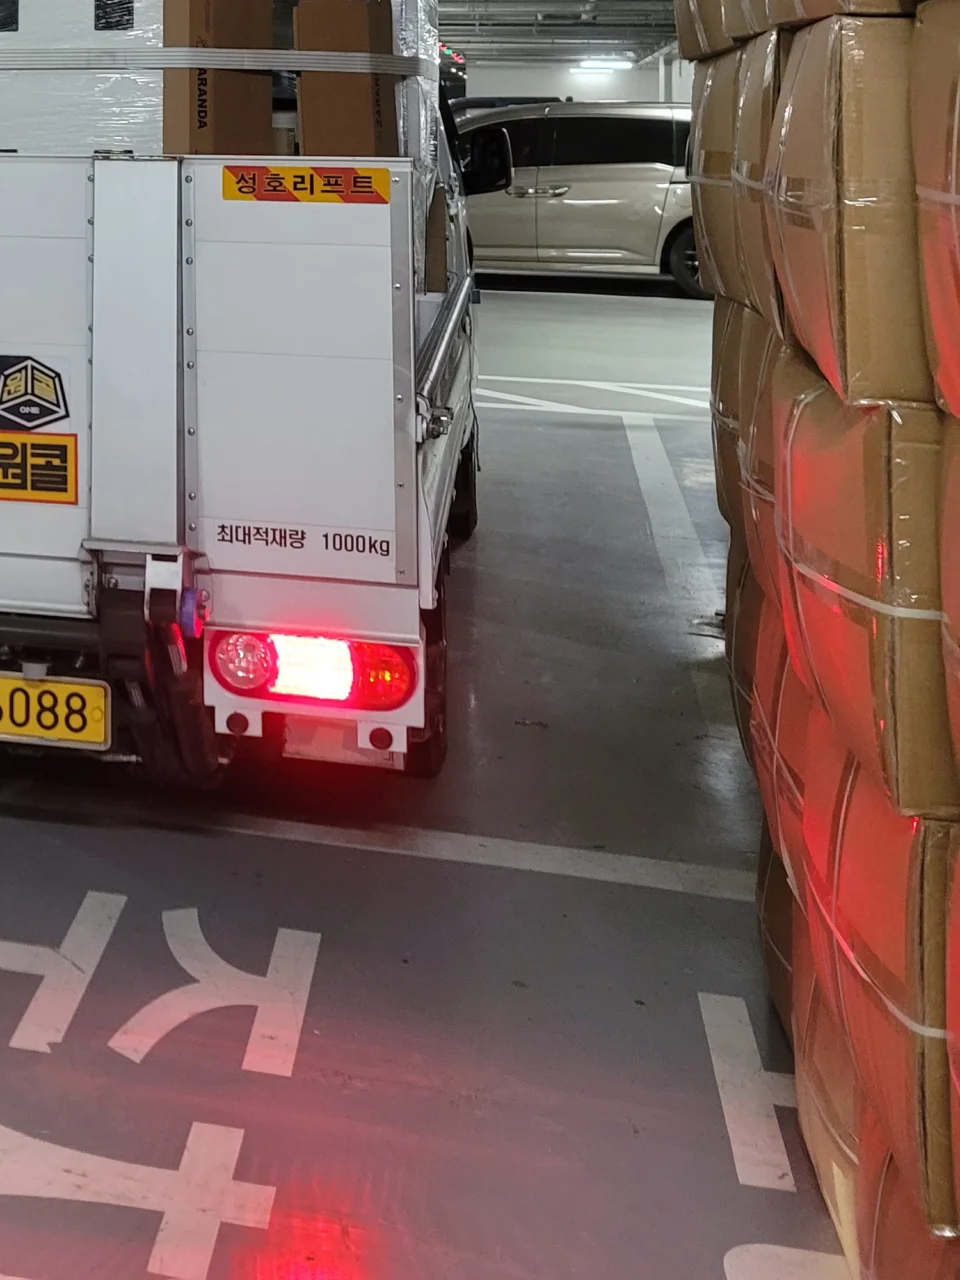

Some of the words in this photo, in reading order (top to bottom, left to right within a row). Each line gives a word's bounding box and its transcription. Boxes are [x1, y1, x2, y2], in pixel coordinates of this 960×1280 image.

[197, 67, 208, 130] ARANDA
[235, 173, 375, 195] 성호리프트
[19, 406, 40, 415] ONE
[217, 524, 306, 549] 최대적재량
[322, 532, 390, 557] 1000kg
